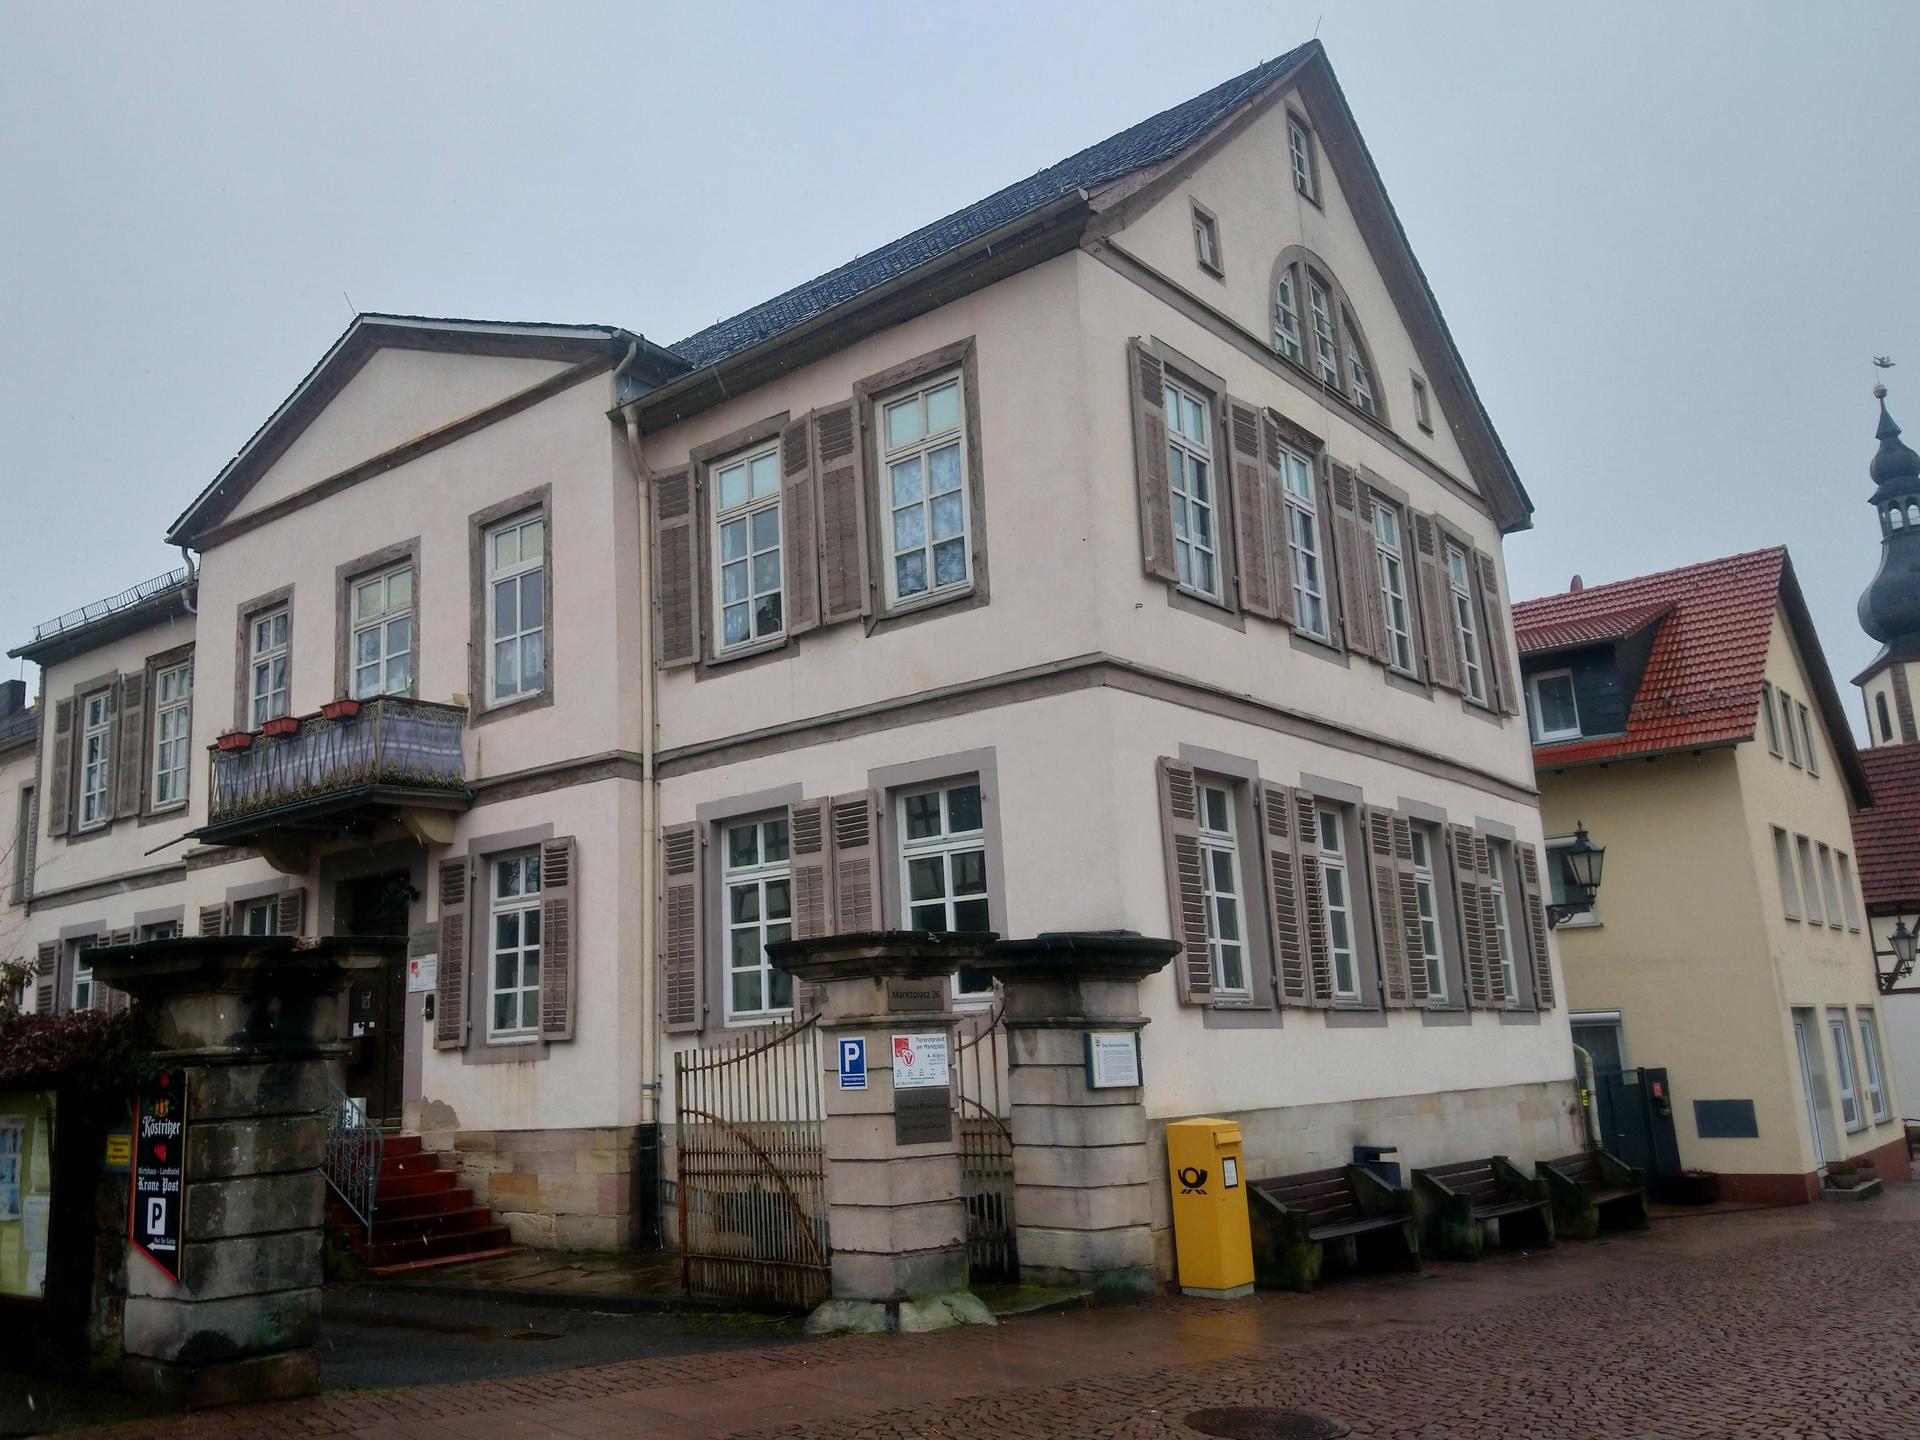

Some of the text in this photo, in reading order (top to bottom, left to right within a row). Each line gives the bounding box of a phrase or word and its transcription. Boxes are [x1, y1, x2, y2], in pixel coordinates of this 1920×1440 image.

[892, 990, 941, 1000] Marktplatz 26
[844, 1042, 860, 1073] P
[142, 1115, 181, 1139] Köstritzer
[138, 1176, 179, 1195] Krone Post
[152, 1203, 162, 1229] P
